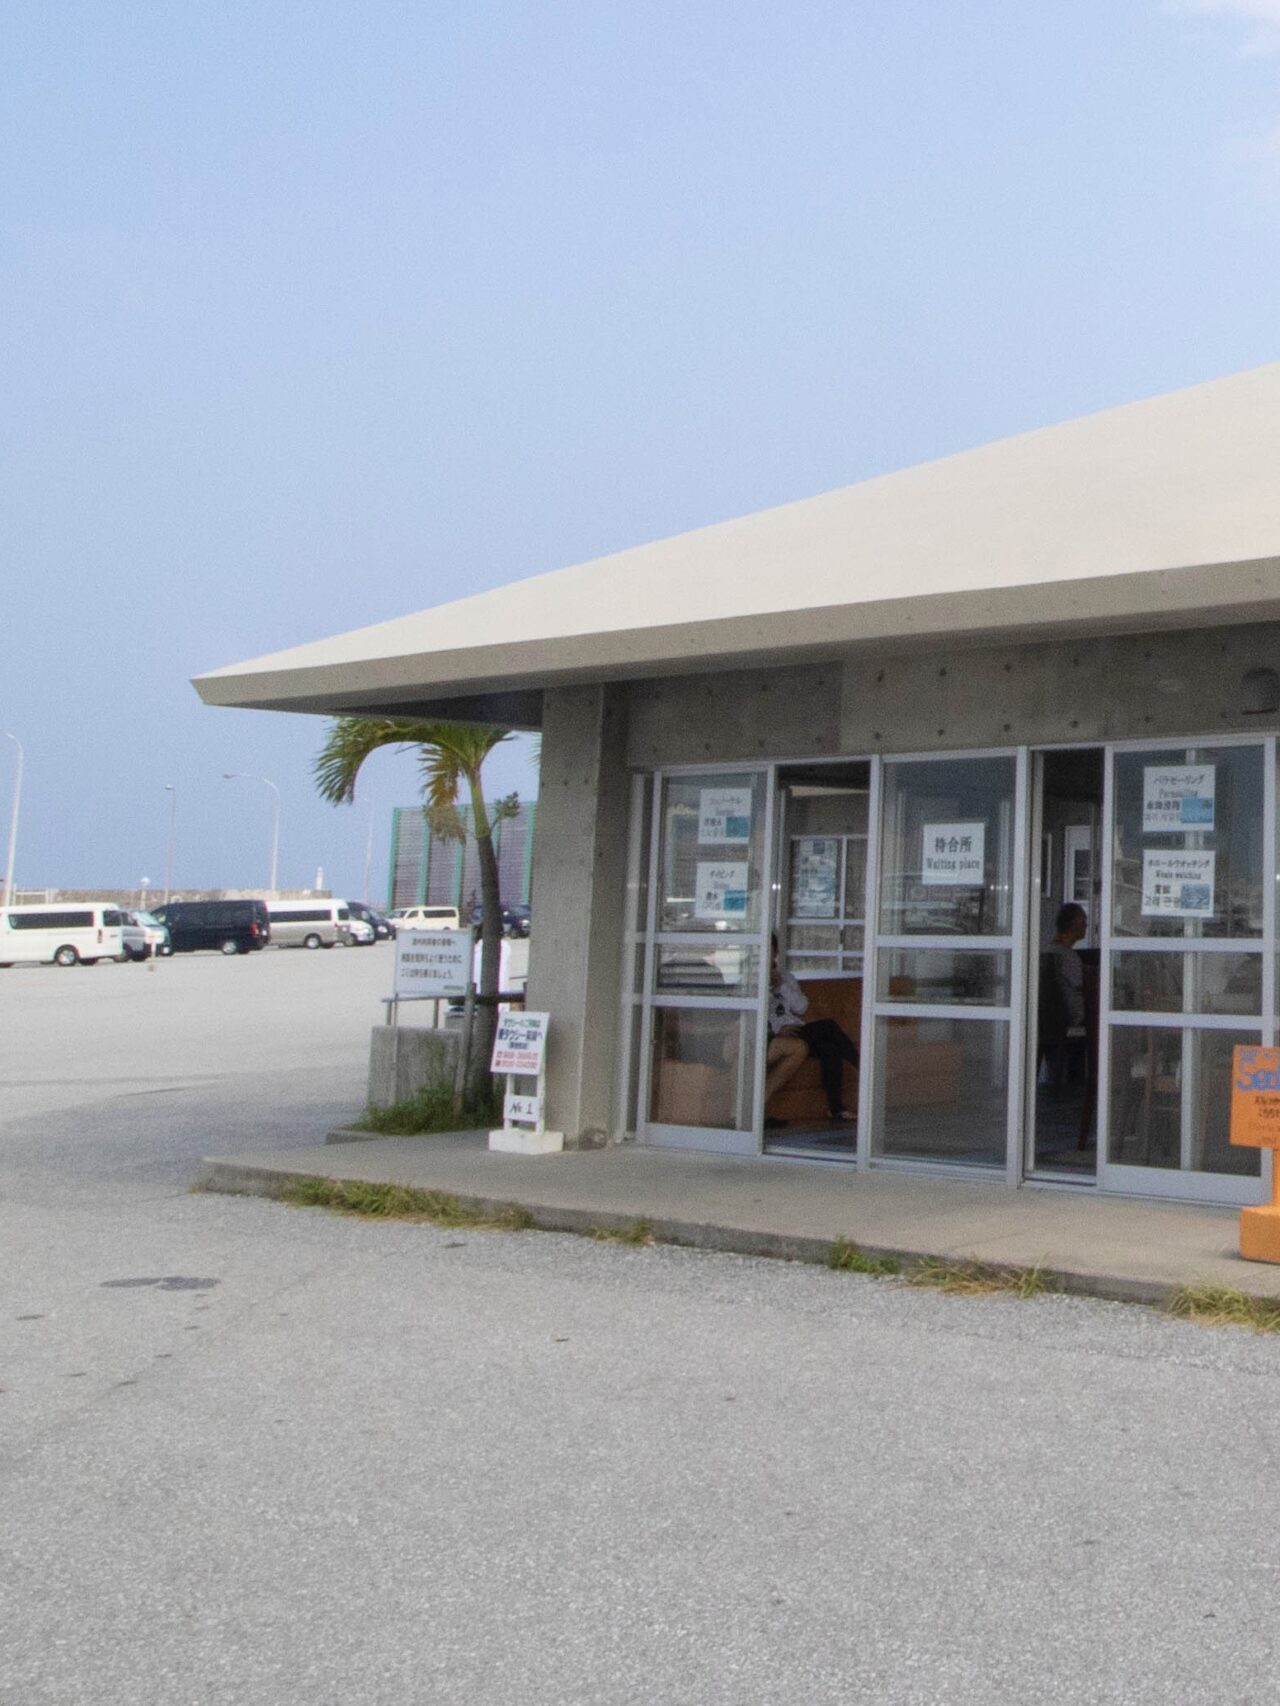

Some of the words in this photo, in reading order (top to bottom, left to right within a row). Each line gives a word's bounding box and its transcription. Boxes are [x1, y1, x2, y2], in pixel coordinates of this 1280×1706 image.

[935, 836, 972, 853] 待合所
[926, 857, 956, 870] Waiting
[959, 857, 980, 870] place
